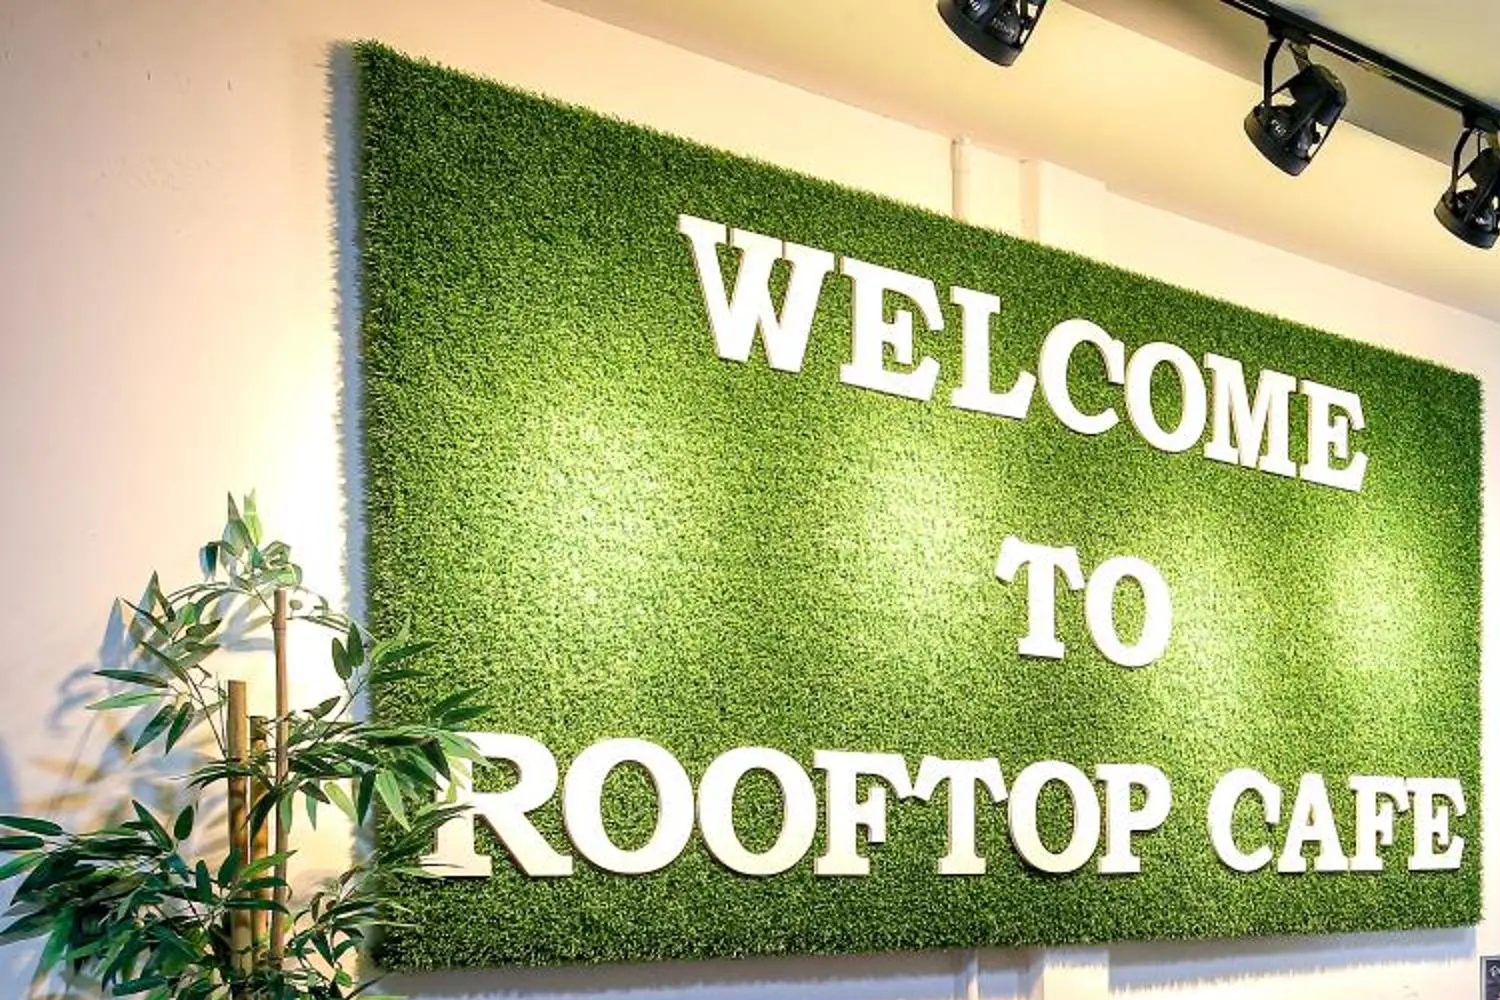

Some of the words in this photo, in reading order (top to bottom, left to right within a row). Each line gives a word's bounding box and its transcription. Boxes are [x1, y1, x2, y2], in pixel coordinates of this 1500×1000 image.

[678, 213, 1369, 491] WELCOME
[995, 535, 1173, 668] TO
[418, 731, 1172, 876] ROOFTOP
[1207, 767, 1467, 874] CAFE
